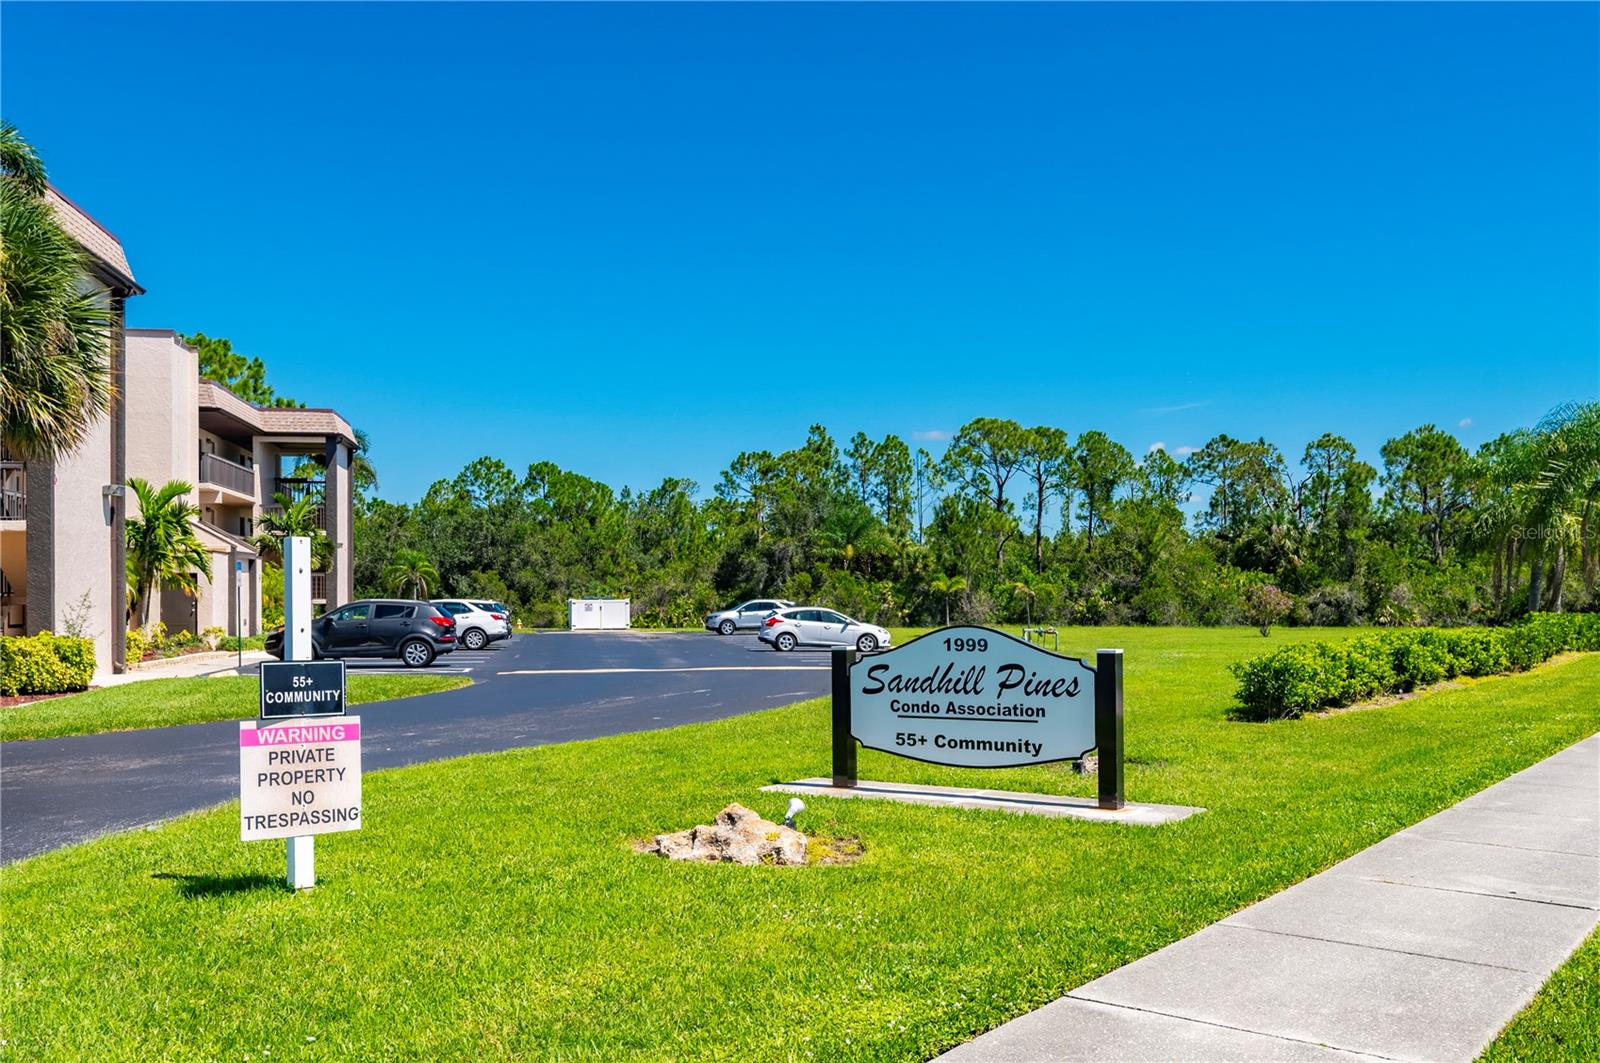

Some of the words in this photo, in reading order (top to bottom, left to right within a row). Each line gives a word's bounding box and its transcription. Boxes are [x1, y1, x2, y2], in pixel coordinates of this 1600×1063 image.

[943, 637, 988, 652] 1999
[292, 676, 314, 688] 55+
[862, 662, 986, 695] Sandhill
[996, 663, 1081, 699] Pines
[266, 690, 340, 704] COMMUNITY
[890, 699, 940, 714] Condo
[945, 701, 1046, 718] Association
[257, 726, 345, 745] WARNING
[895, 732, 928, 747] 55+
[934, 734, 1043, 757] Community
[268, 748, 335, 765] PRIVATE
[257, 767, 346, 787] PROPERTY
[291, 790, 315, 805] NO
[244, 807, 359, 830] TRESPASSING
